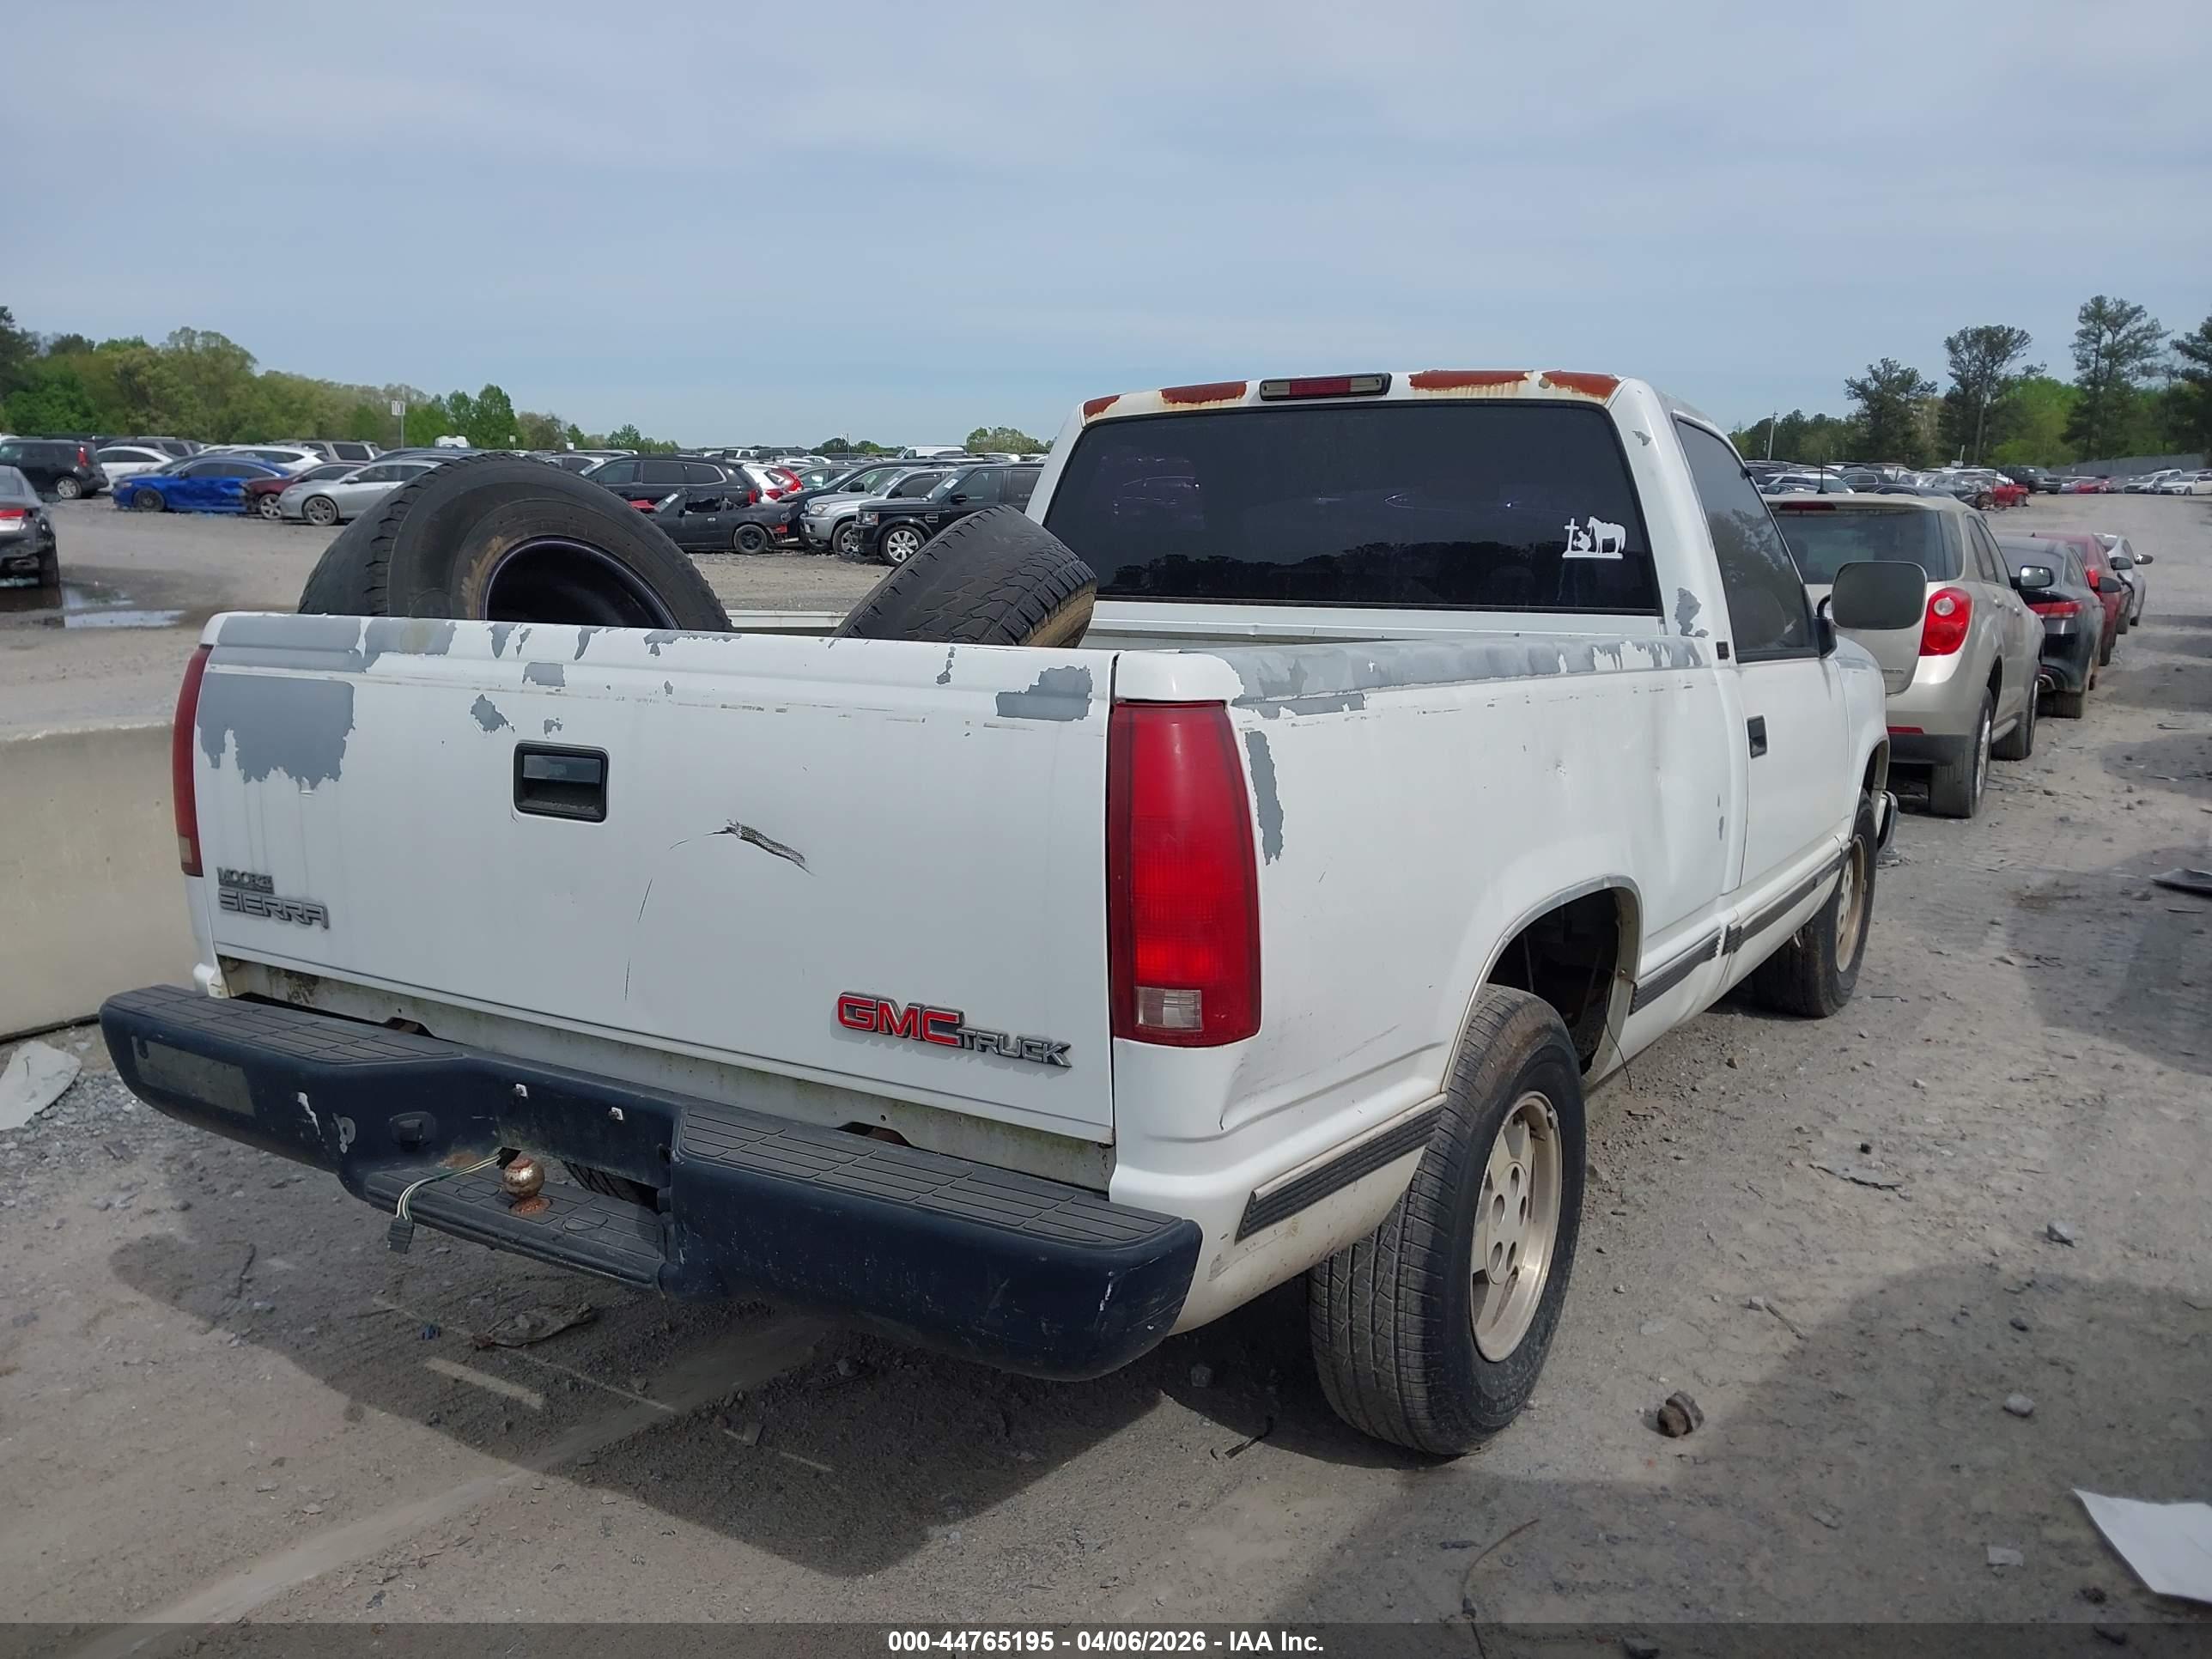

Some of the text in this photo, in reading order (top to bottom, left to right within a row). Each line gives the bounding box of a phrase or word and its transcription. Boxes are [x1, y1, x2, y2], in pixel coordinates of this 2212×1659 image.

[219, 888, 329, 929] SIERRA
[837, 991, 1072, 1067] GMC TRUCK
